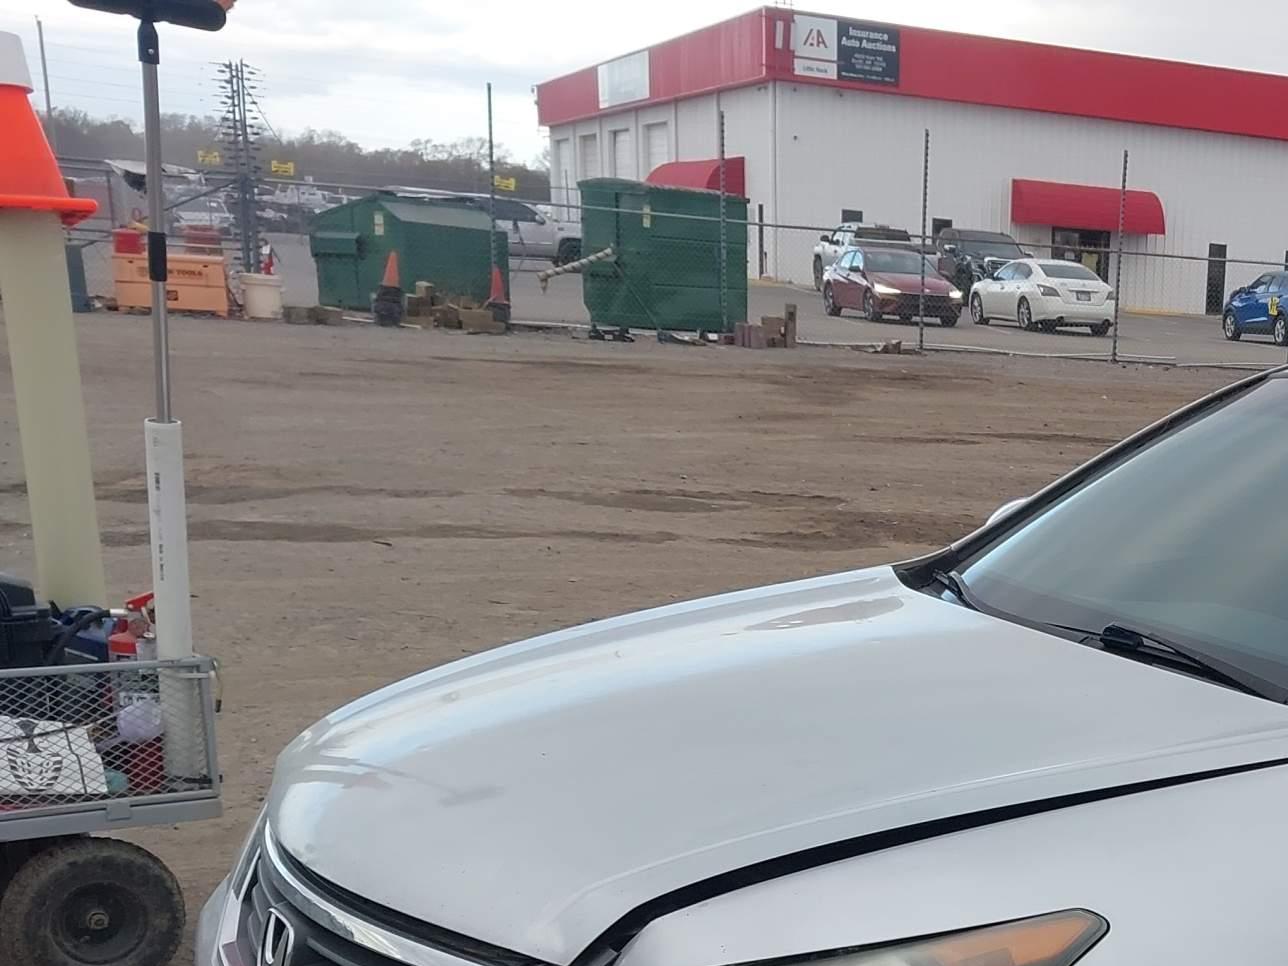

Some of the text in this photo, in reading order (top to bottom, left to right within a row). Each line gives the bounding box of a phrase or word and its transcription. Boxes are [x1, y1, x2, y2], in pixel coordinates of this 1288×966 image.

[848, 26, 889, 41] Insurance
[841, 36, 897, 53] Auto Auctions
